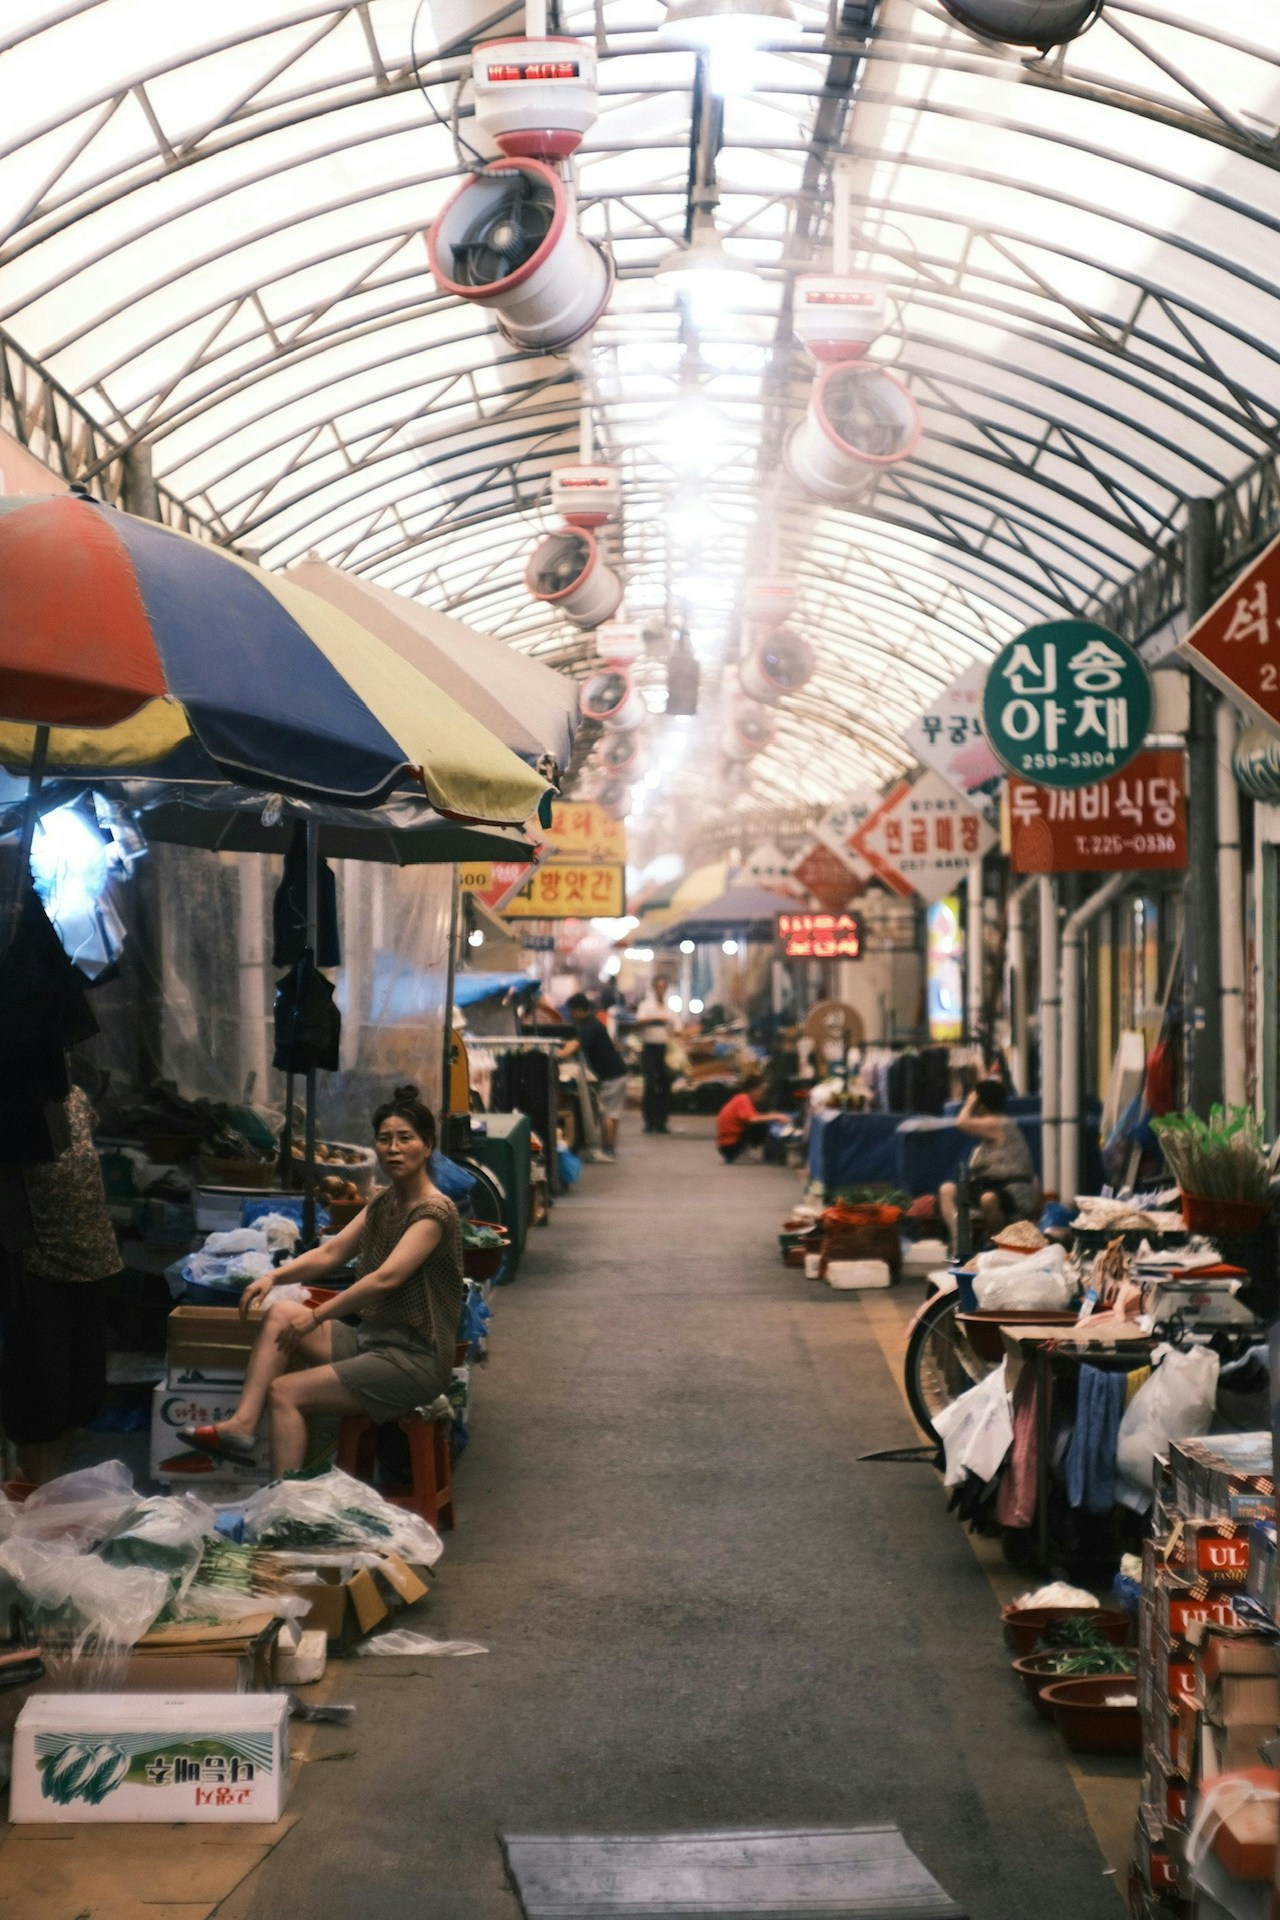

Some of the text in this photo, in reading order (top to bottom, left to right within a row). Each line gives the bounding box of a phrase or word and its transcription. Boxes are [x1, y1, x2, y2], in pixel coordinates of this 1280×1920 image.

[1002, 640, 1127, 694] 신송
[1001, 696, 1129, 751] 야채
[1021, 752, 1116, 769] 259-3304
[1012, 777, 1180, 827] 두꺼비식당
[146, 1757, 255, 1784] 다듬배추
[195, 1786, 254, 1806] 고랭지
